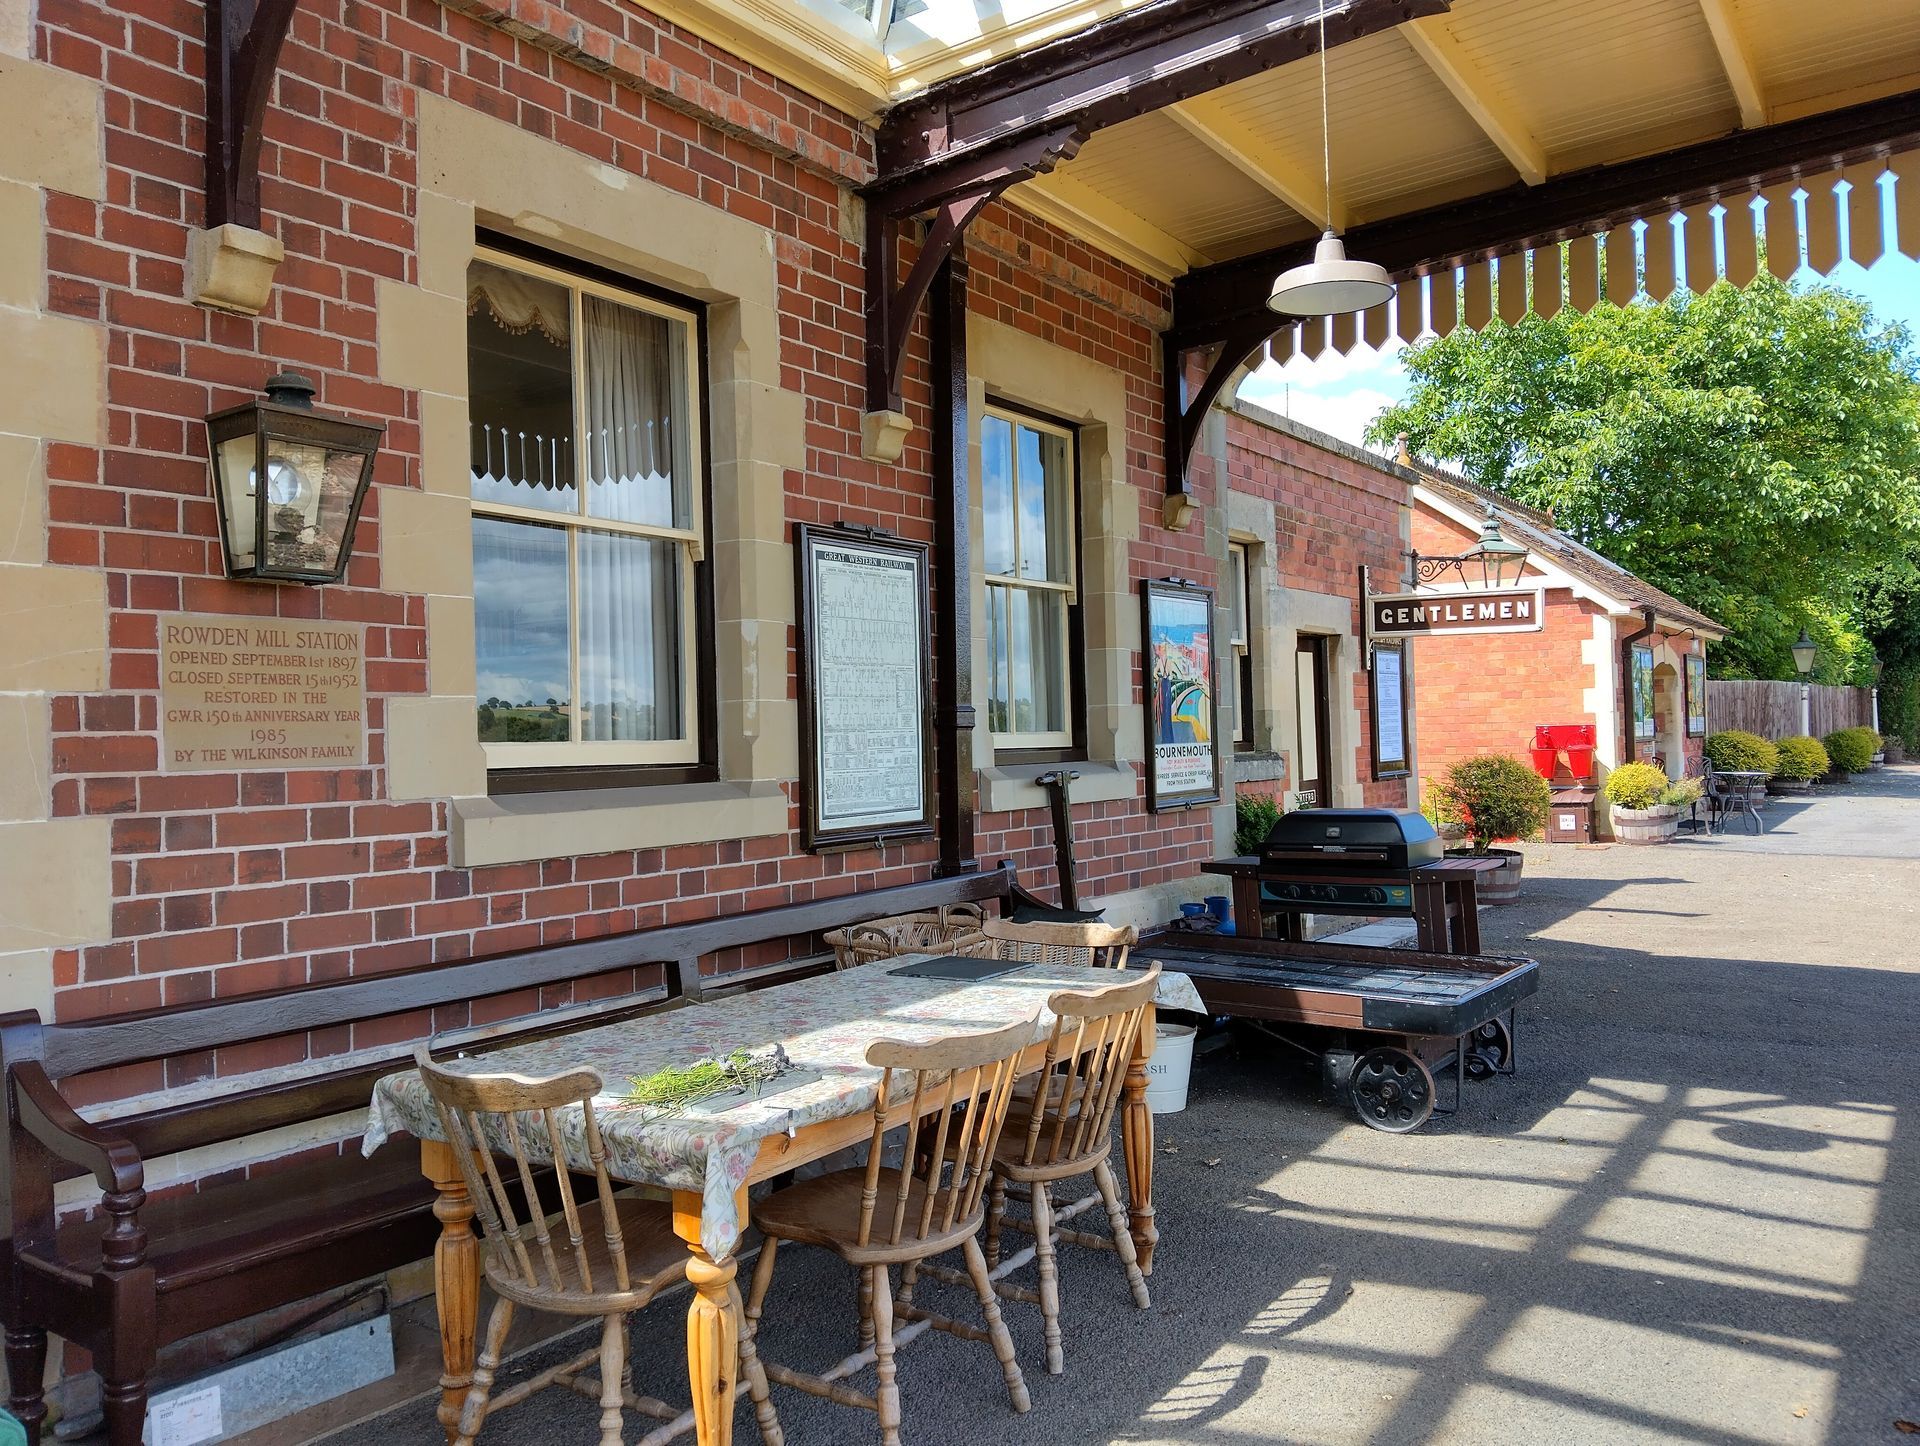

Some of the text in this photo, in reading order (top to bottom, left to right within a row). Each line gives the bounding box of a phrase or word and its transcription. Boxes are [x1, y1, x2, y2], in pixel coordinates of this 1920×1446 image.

[824, 552, 845, 562] GREAT
[849, 555, 878, 565] WESTERN
[880, 559, 907, 569] RAILWAY
[1381, 600, 1530, 624] GENTLEMEN
[167, 625, 358, 651] ROWDEN MILL STATION
[169, 651, 357, 672] OPENED SEPTEMBER 1st 1897
[168, 671, 223, 684] CLOSED
[227, 672, 302, 686] SEPTEMBER
[329, 675, 358, 688] 1952
[204, 692, 328, 704] RESTORED IN THE
[167, 710, 203, 723] G.W.R
[244, 710, 330, 722] ANNIVERSARY
[335, 710, 361, 722] YEAR
[250, 728, 287, 745] 1985
[175, 746, 356, 762] BY THE WILKINSON FAMILY
[1155, 745, 1213, 758] BOURNEMOUTH
